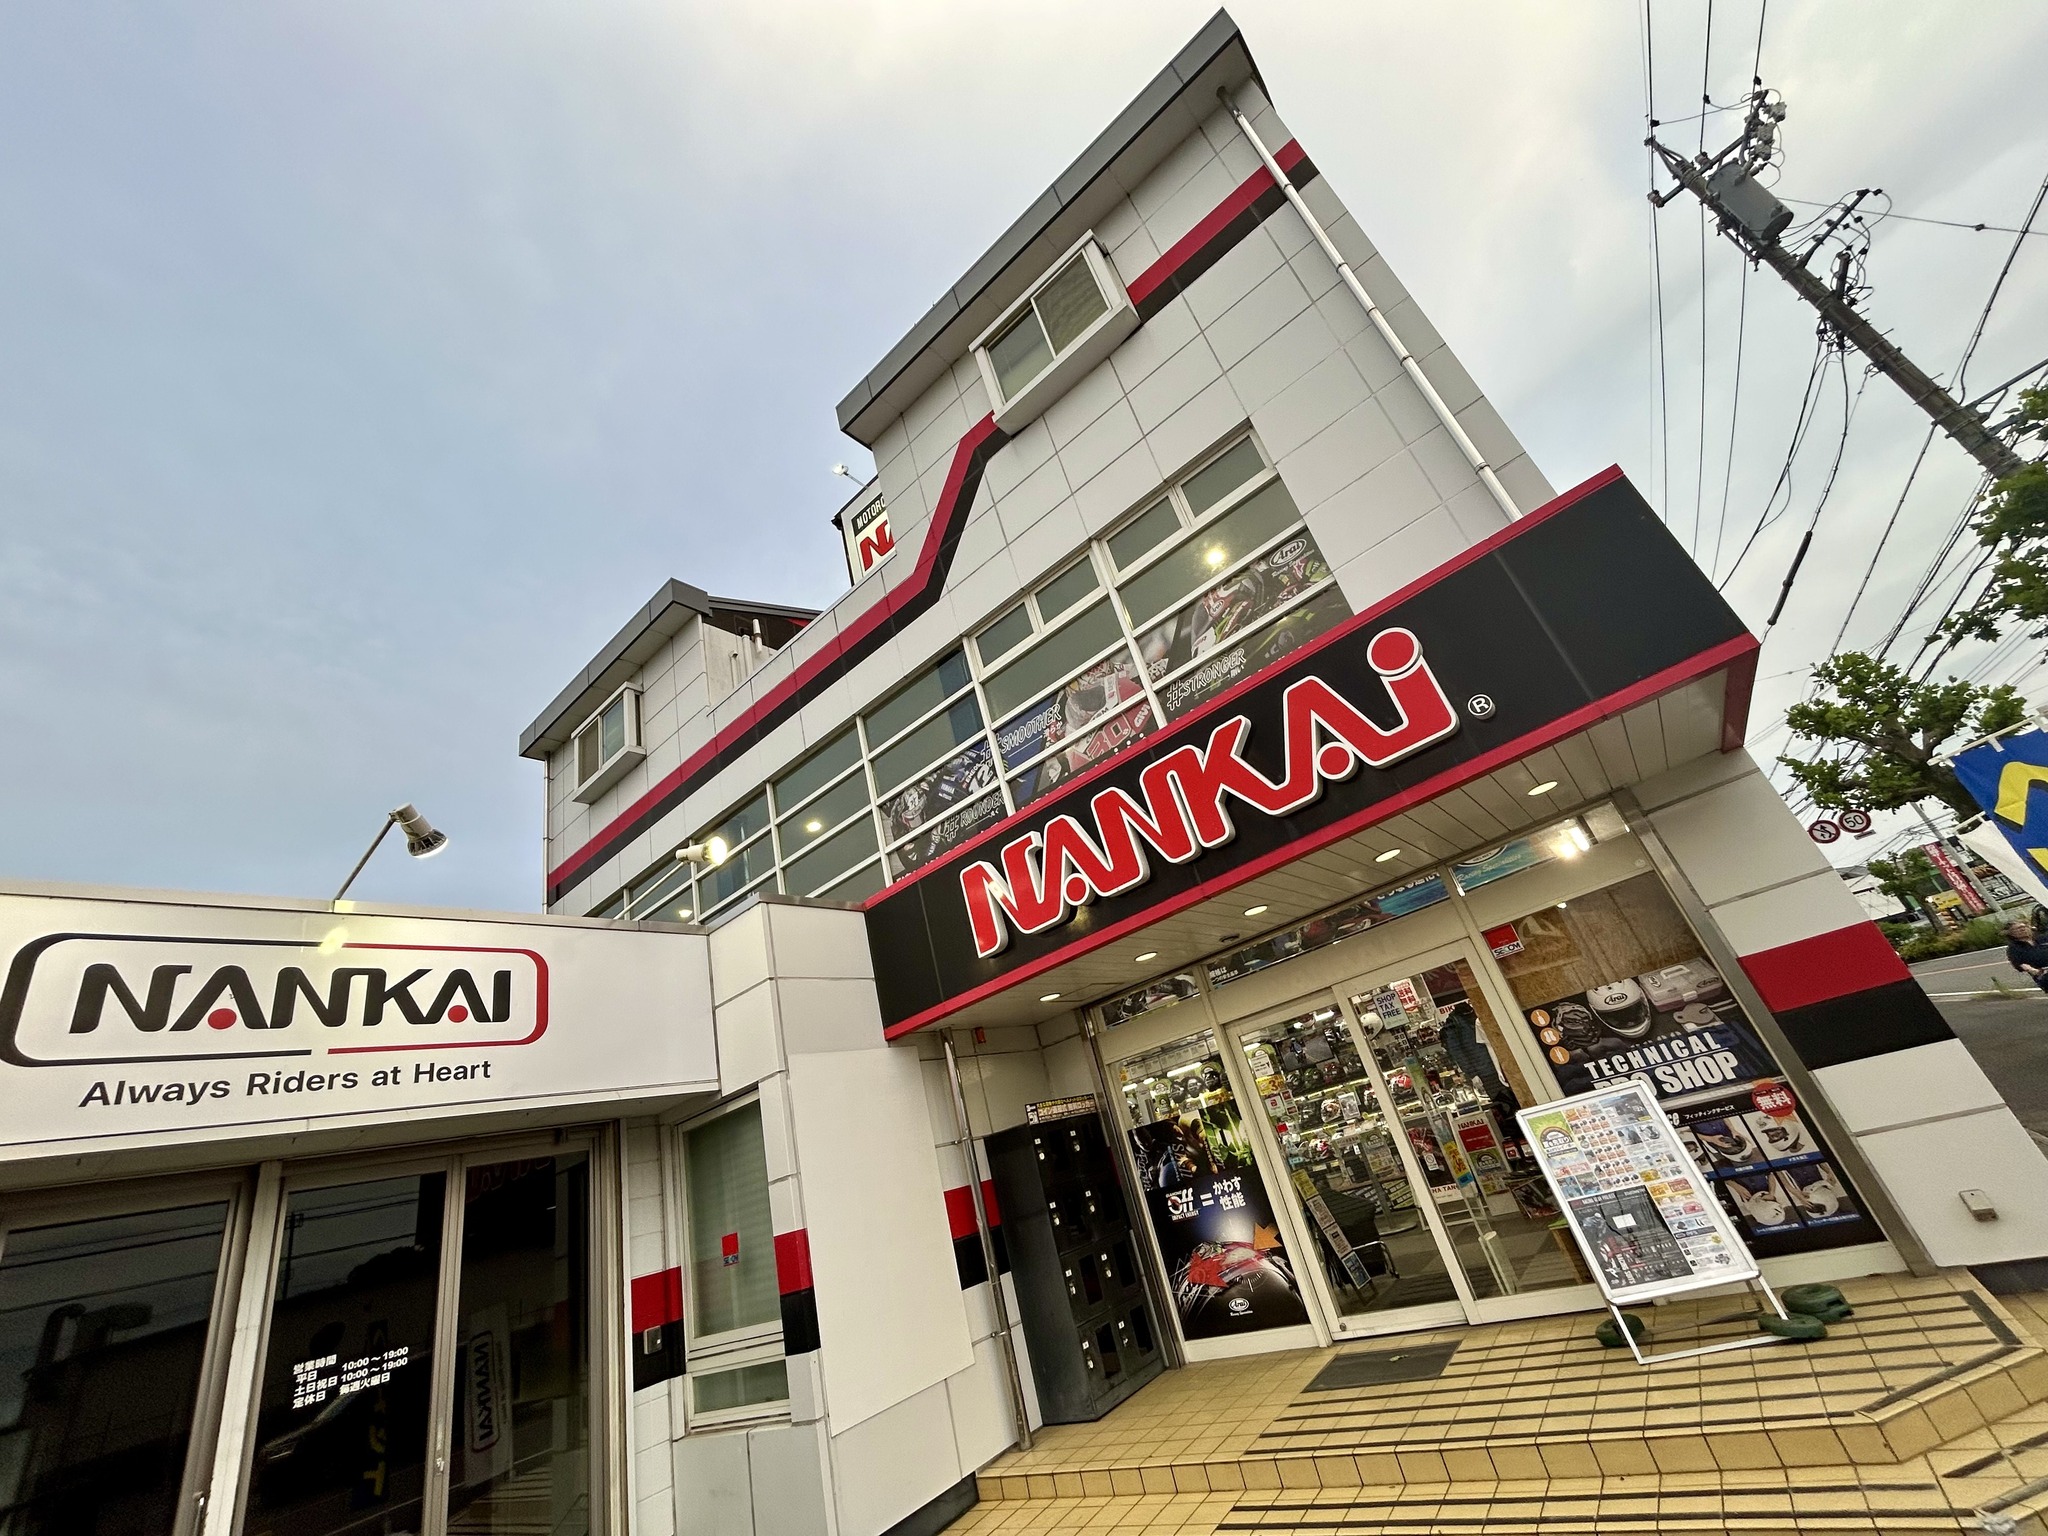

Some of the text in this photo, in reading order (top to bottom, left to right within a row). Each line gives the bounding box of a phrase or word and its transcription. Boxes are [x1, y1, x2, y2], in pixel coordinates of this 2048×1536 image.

[860, 519, 895, 571] N
[959, 626, 1462, 961] NANKAI
[1844, 814, 1865, 828] 50
[69, 962, 512, 1034] NANKAI
[1376, 993, 1396, 1005] SHOP
[1380, 1003, 1395, 1012] TAX
[1607, 993, 1625, 1004] Arai
[1382, 1008, 1402, 1020] FREE
[1439, 1004, 1456, 1015] BIK
[1583, 1031, 1722, 1080] TECHNICAL
[1654, 1051, 1739, 1094] SHOP
[78, 1060, 491, 1108] Always Riders at Heart
[1756, 1090, 1792, 1111] 無料
[1683, 1104, 1735, 1120] フィッティングサービス
[1212, 1176, 1242, 1196] かわす
[1219, 1192, 1247, 1211] 性能
[293, 1354, 338, 1375] 営業時間
[293, 1375, 338, 1397] 土日祝日
[296, 1370, 318, 1384] 平日
[292, 1372, 391, 1409] 定休日 毎週火曜日
